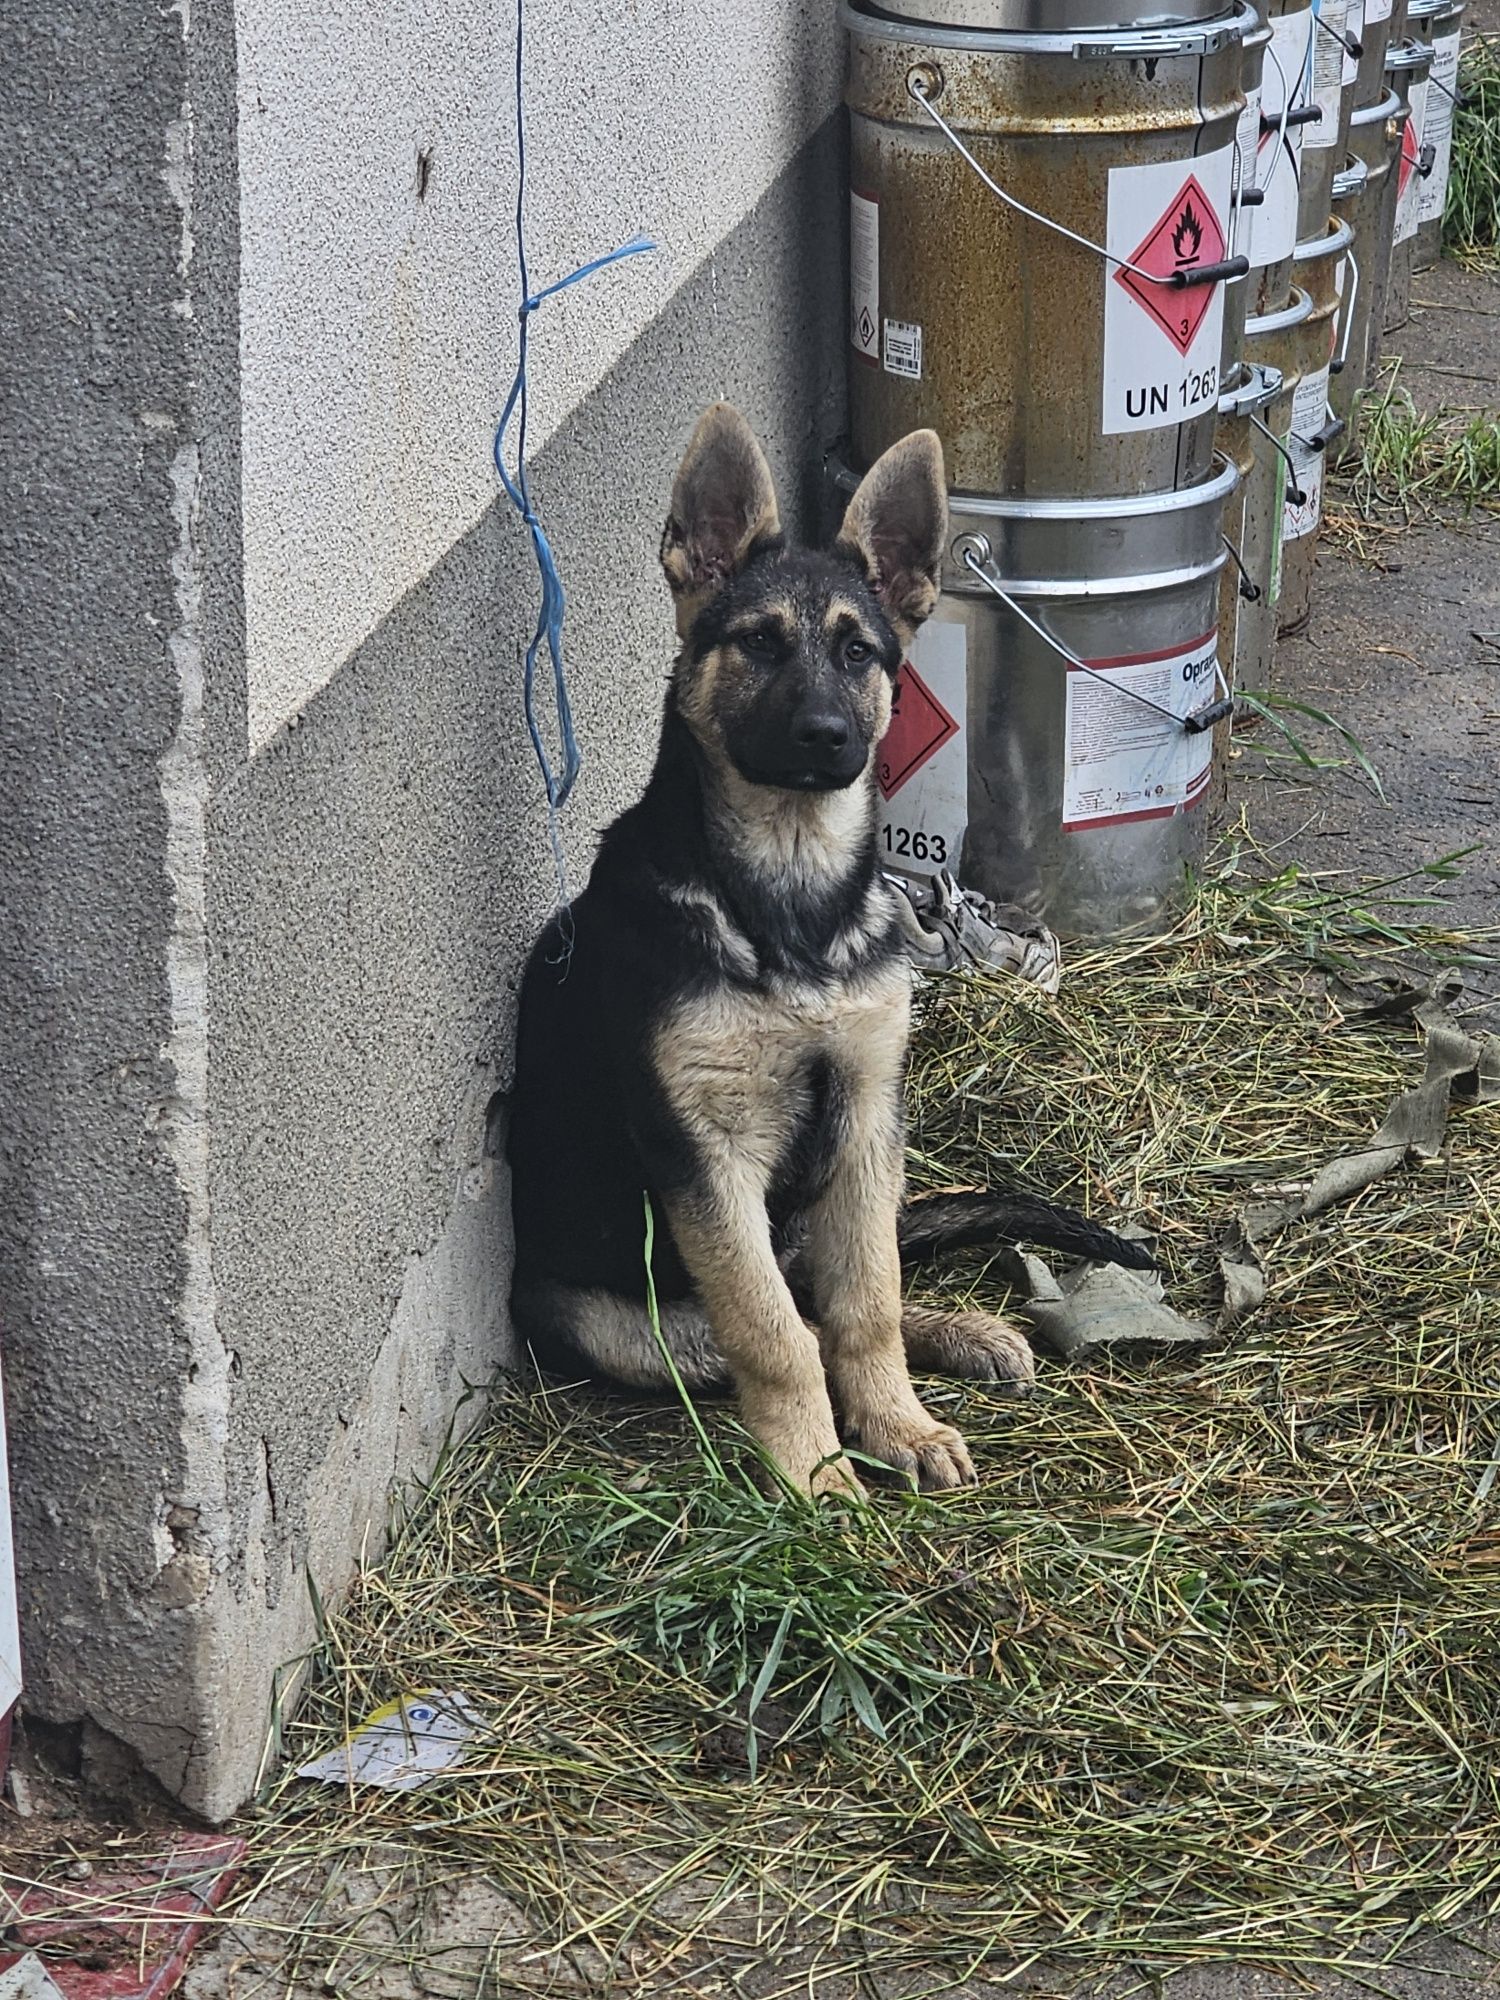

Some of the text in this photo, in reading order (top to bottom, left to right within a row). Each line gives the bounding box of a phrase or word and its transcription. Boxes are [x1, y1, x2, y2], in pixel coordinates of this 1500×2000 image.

[1180, 319, 1189, 336] 3
[1126, 365, 1216, 418] UN 1263
[882, 763, 890, 780] 3
[882, 823, 947, 863] 1263
